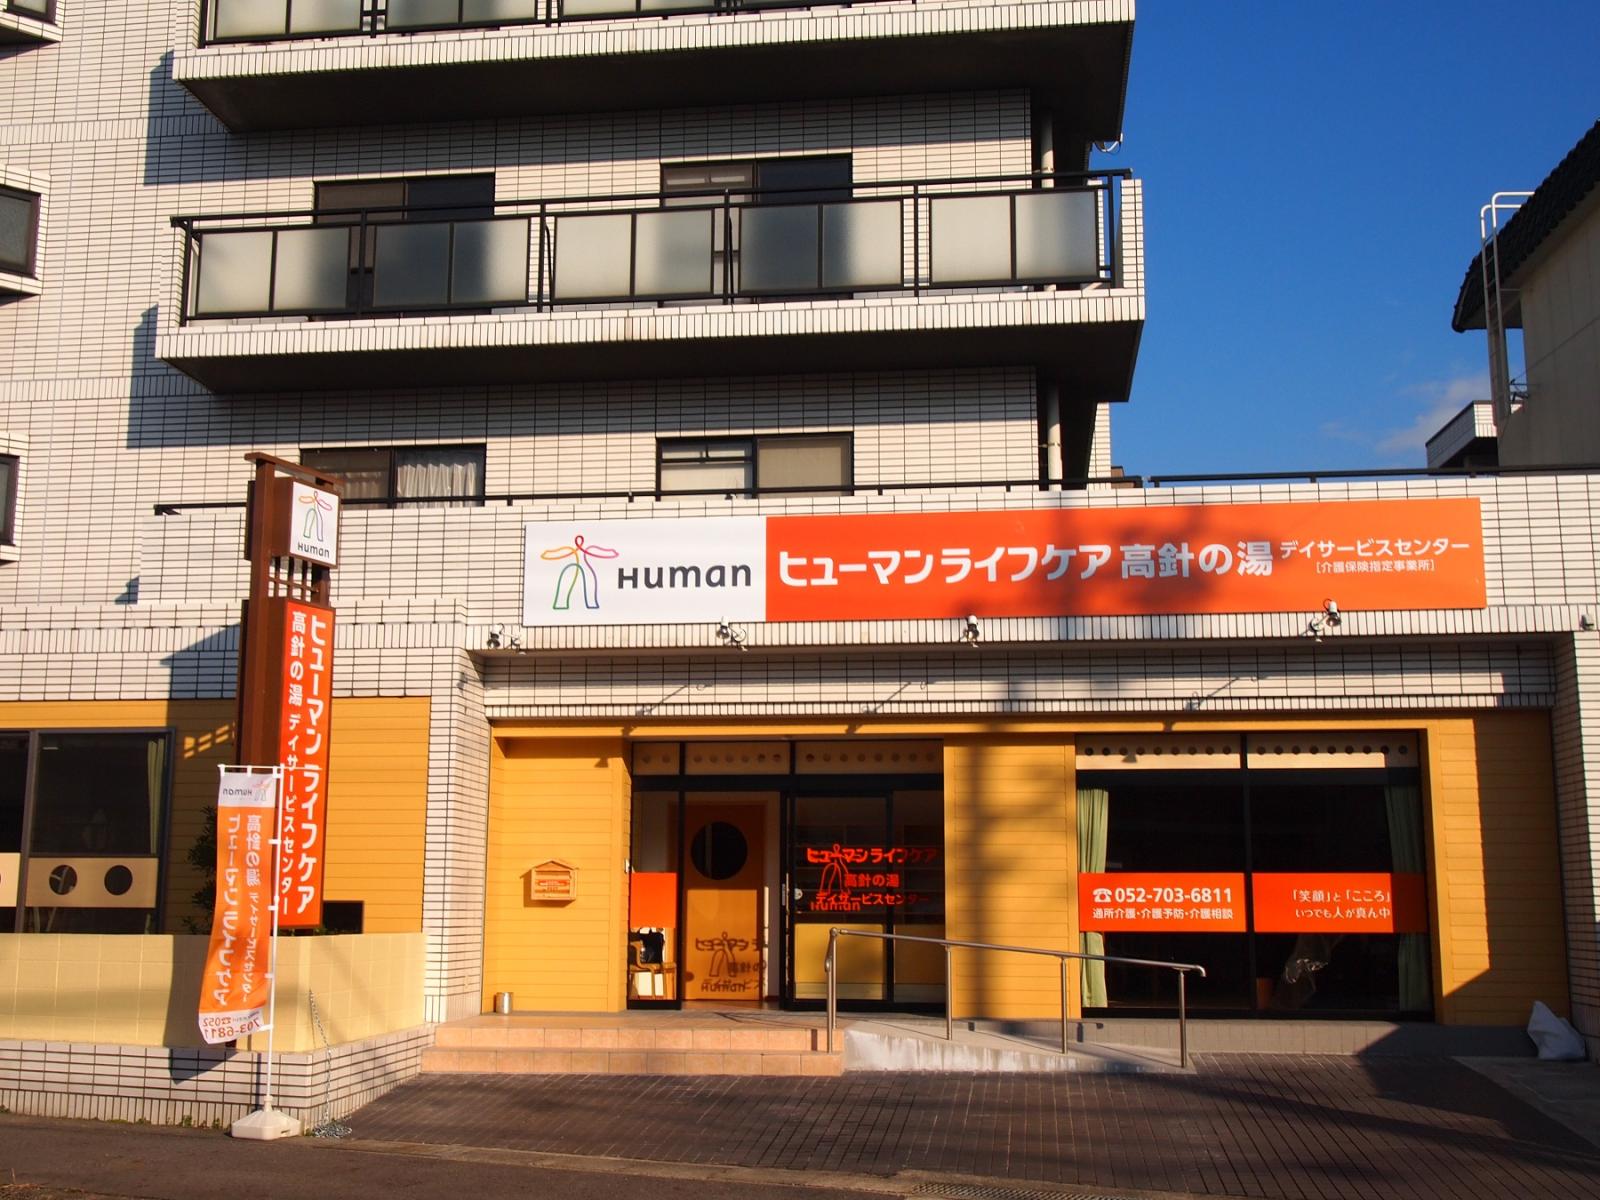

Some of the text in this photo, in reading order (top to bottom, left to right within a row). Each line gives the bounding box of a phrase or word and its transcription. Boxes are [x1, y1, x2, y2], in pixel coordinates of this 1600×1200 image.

[1280, 537, 1470, 559] デイサービスセンター
[779, 541, 1273, 588] ヒューマンライフケア 高針の湯
[281, 611, 306, 915] 高針の湯 デイサービスセンター
[1115, 887, 1232, 904] 052-703-6811
[1295, 906, 1391, 919] いつでも人が真ん中
